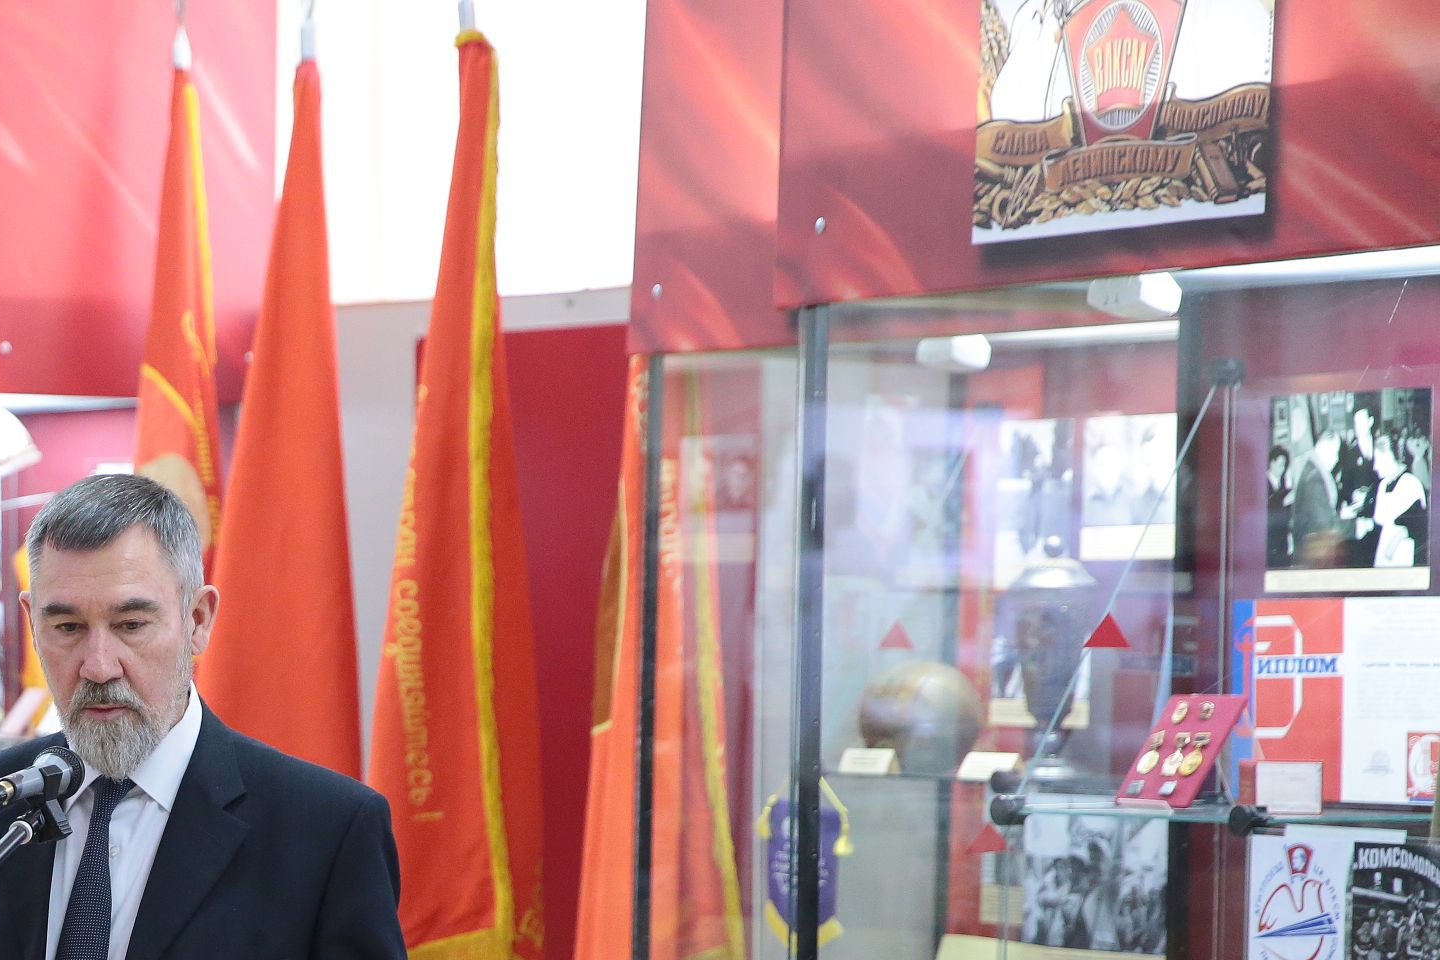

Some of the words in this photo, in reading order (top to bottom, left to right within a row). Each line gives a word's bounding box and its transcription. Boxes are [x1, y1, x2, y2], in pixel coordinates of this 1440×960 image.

[1094, 38, 1148, 93] ВЛКСМ
[1163, 91, 1271, 131] КОМСОМОЛУ
[993, 130, 1049, 156] СЛАВА
[1061, 147, 1182, 185] ЛЕНИНСКОМУ
